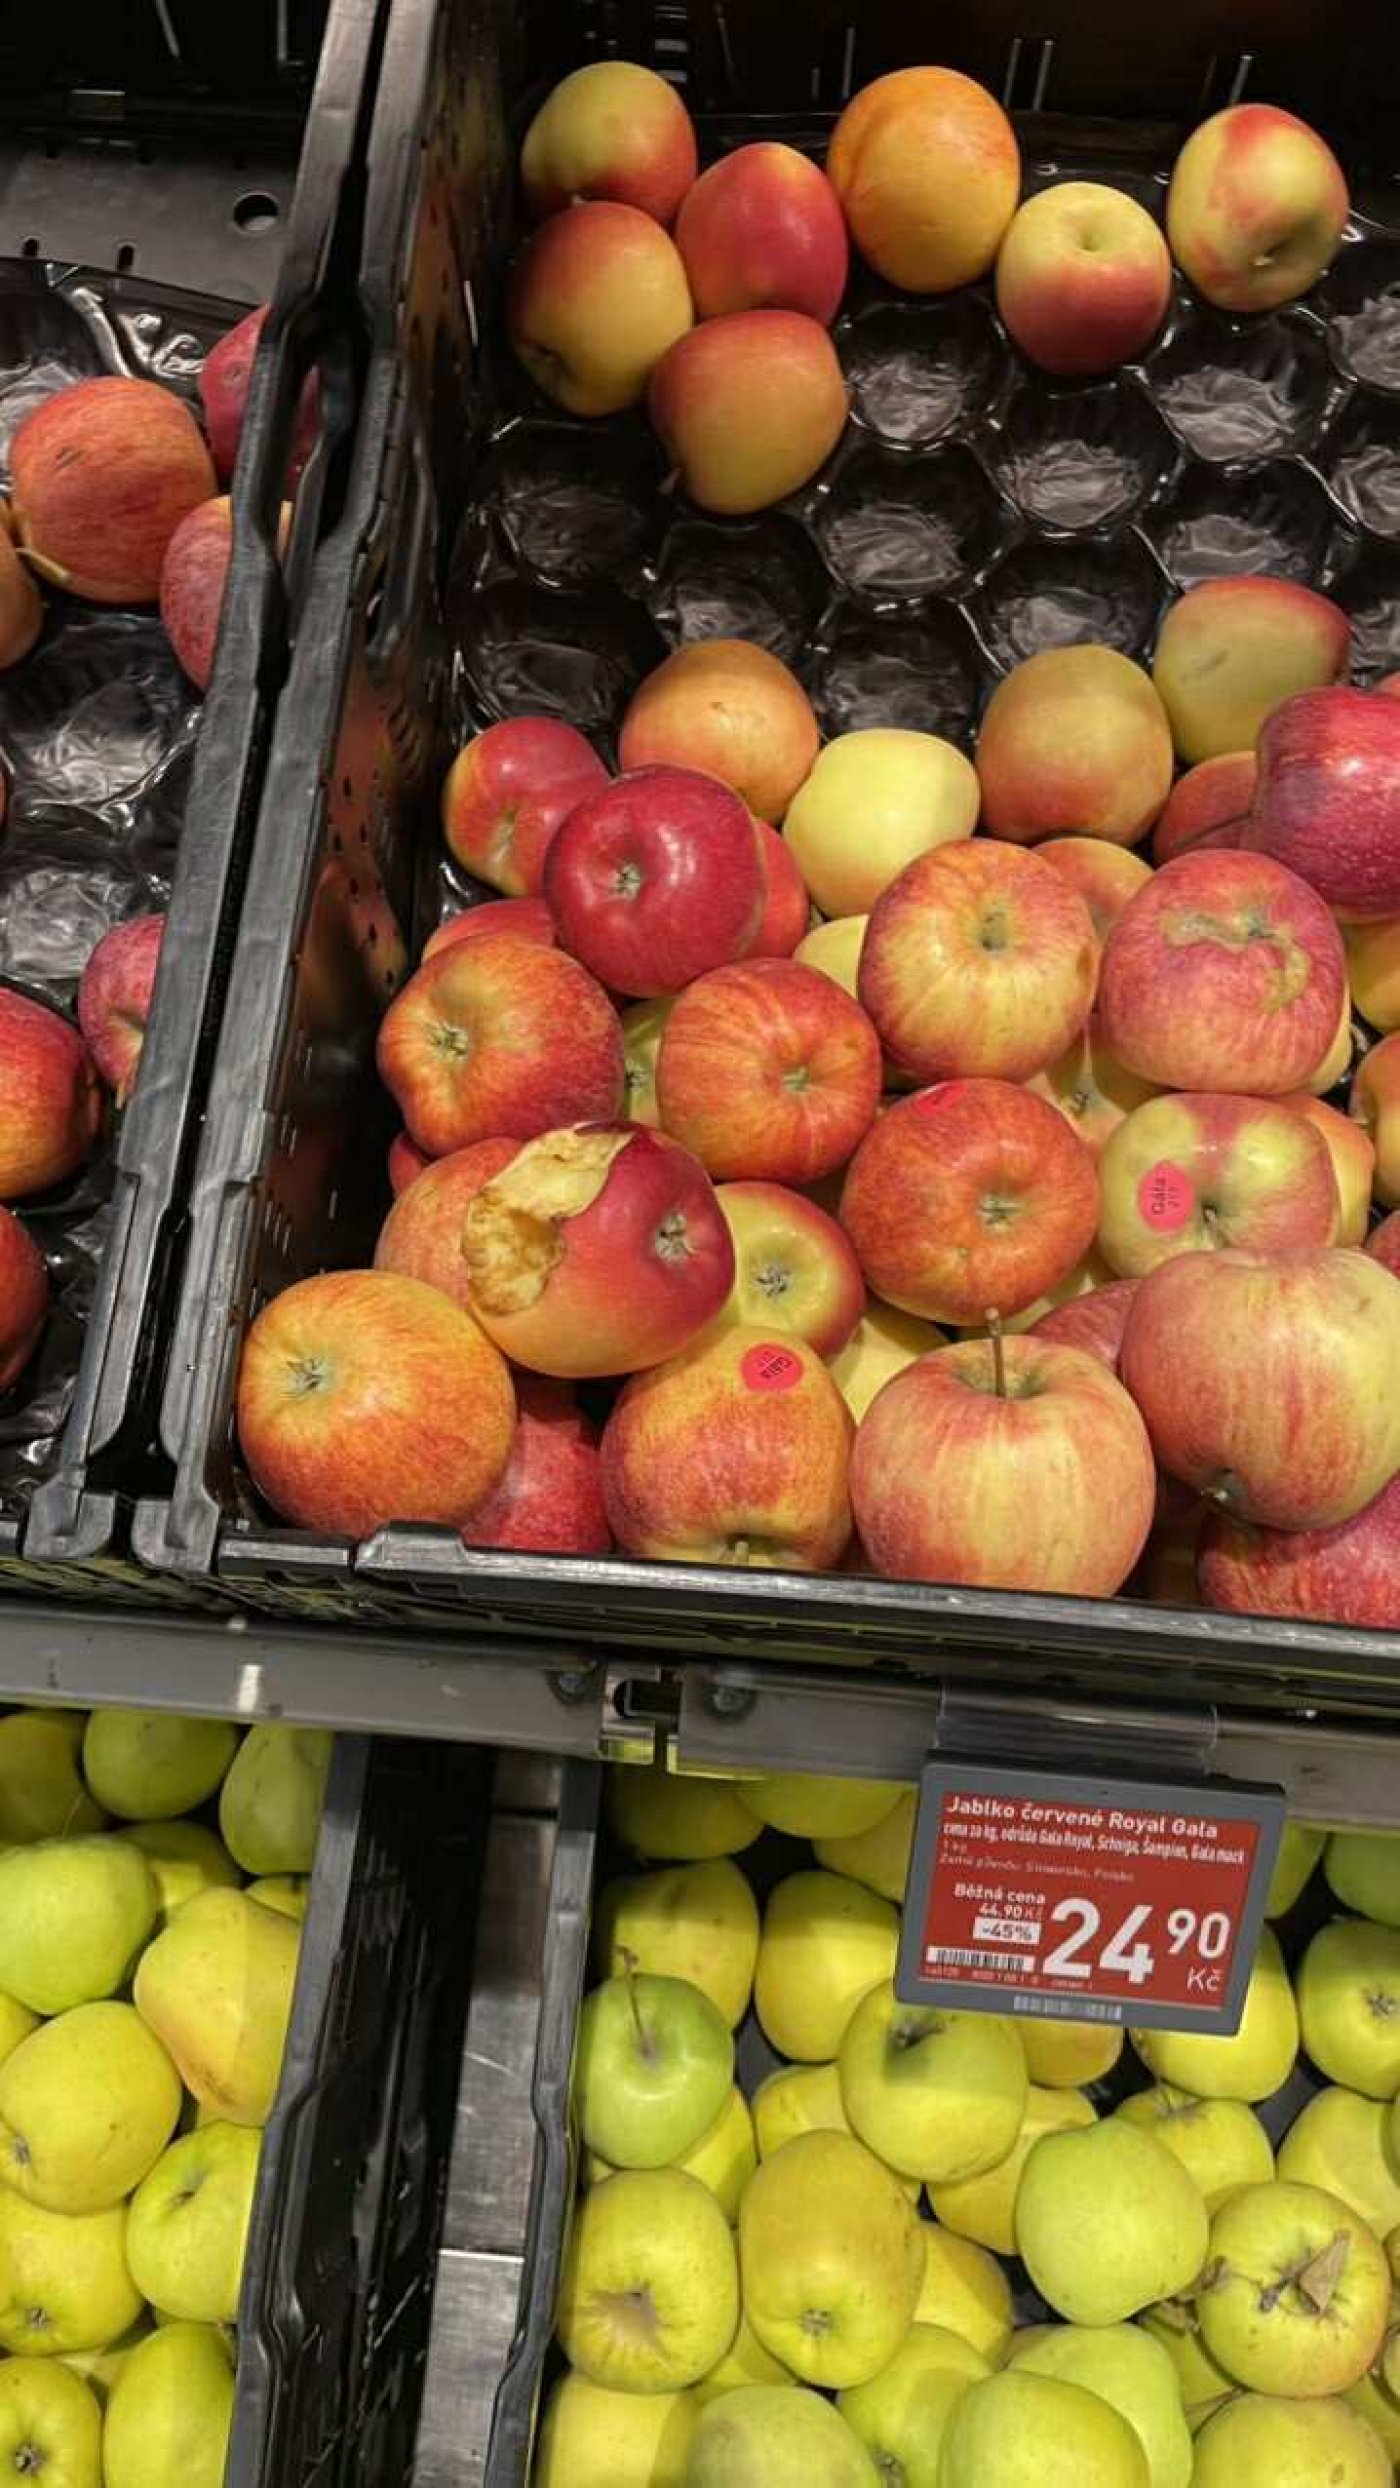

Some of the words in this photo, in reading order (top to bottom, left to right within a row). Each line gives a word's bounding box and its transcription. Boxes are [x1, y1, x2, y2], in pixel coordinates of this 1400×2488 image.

[947, 1796, 1015, 1819] Jablko
[1021, 1802, 1103, 1827] červené
[1109, 1811, 1165, 1835] Royal
[1171, 1818, 1218, 1838] Gala
[943, 1824, 968, 1836] cena
[1039, 1829, 1062, 1846] Gala
[954, 1881, 1002, 1900] Běžná
[1008, 1890, 1046, 1904] cena
[979, 1903, 1023, 1918] 44.90
[982, 1920, 1033, 1941] -45%
[1043, 1898, 1154, 1985] 24
[1167, 1909, 1231, 1959] 90
[1187, 1967, 1223, 1992] Kč
